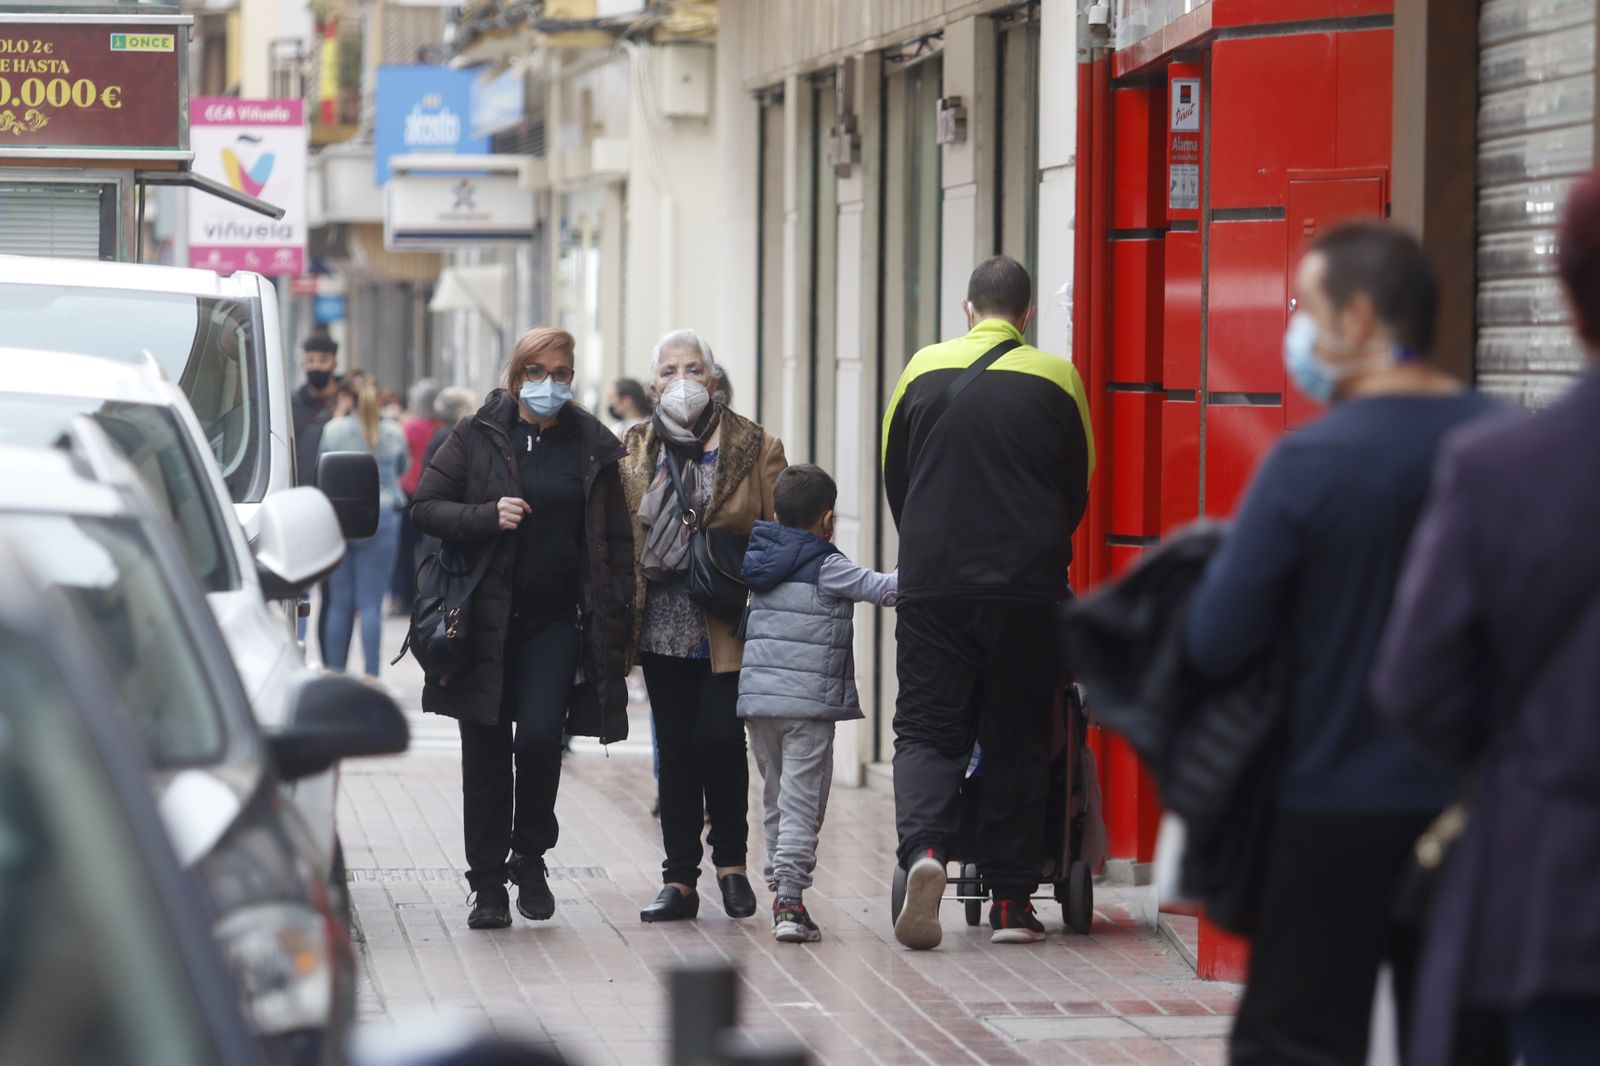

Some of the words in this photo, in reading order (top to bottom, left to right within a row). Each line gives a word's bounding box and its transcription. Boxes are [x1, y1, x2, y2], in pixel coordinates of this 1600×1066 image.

[129, 37, 170, 48] ONCE
[13, 58, 70, 74] HASTA
[1172, 135, 1198, 151] Alarma
[202, 217, 294, 241] viñuela
